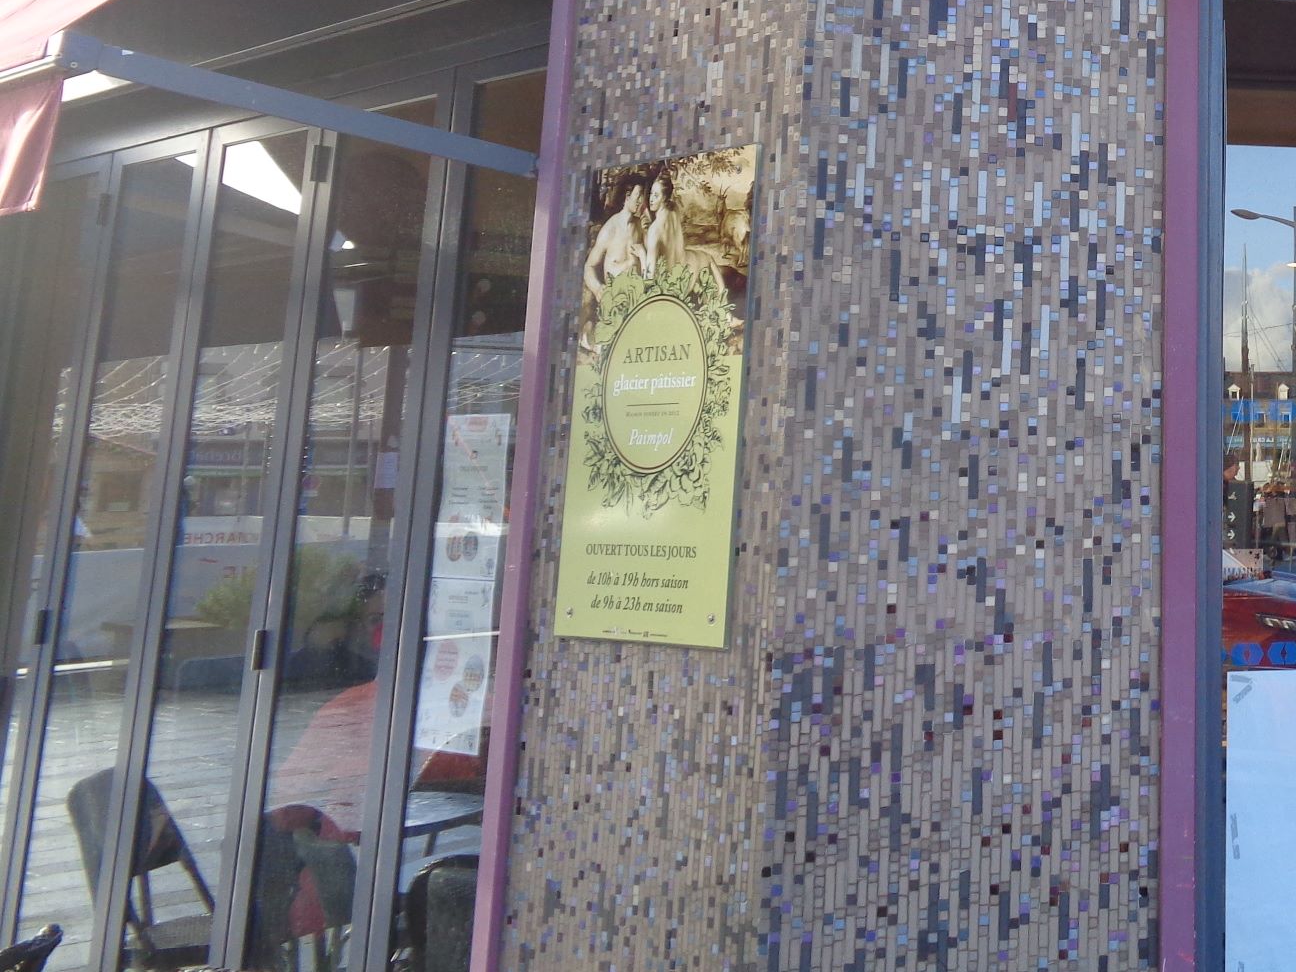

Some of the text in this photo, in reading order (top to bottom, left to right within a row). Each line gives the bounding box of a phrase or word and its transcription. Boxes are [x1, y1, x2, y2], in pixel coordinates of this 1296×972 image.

[623, 343, 692, 364] ARTISAN
[612, 372, 697, 397] glacier pâtissier
[629, 428, 674, 451] Paimpol
[585, 543, 697, 560] OUVERT TOUS LES JOURS
[587, 571, 596, 585] de
[597, 572, 612, 585] 10h
[622, 572, 639, 587] 19h
[640, 572, 660, 588] hors
[661, 574, 689, 589] saison
[590, 594, 601, 609] de
[602, 595, 615, 610] 9h
[623, 597, 641, 611] 23h
[642, 601, 654, 612] en
[655, 599, 683, 614] saison
